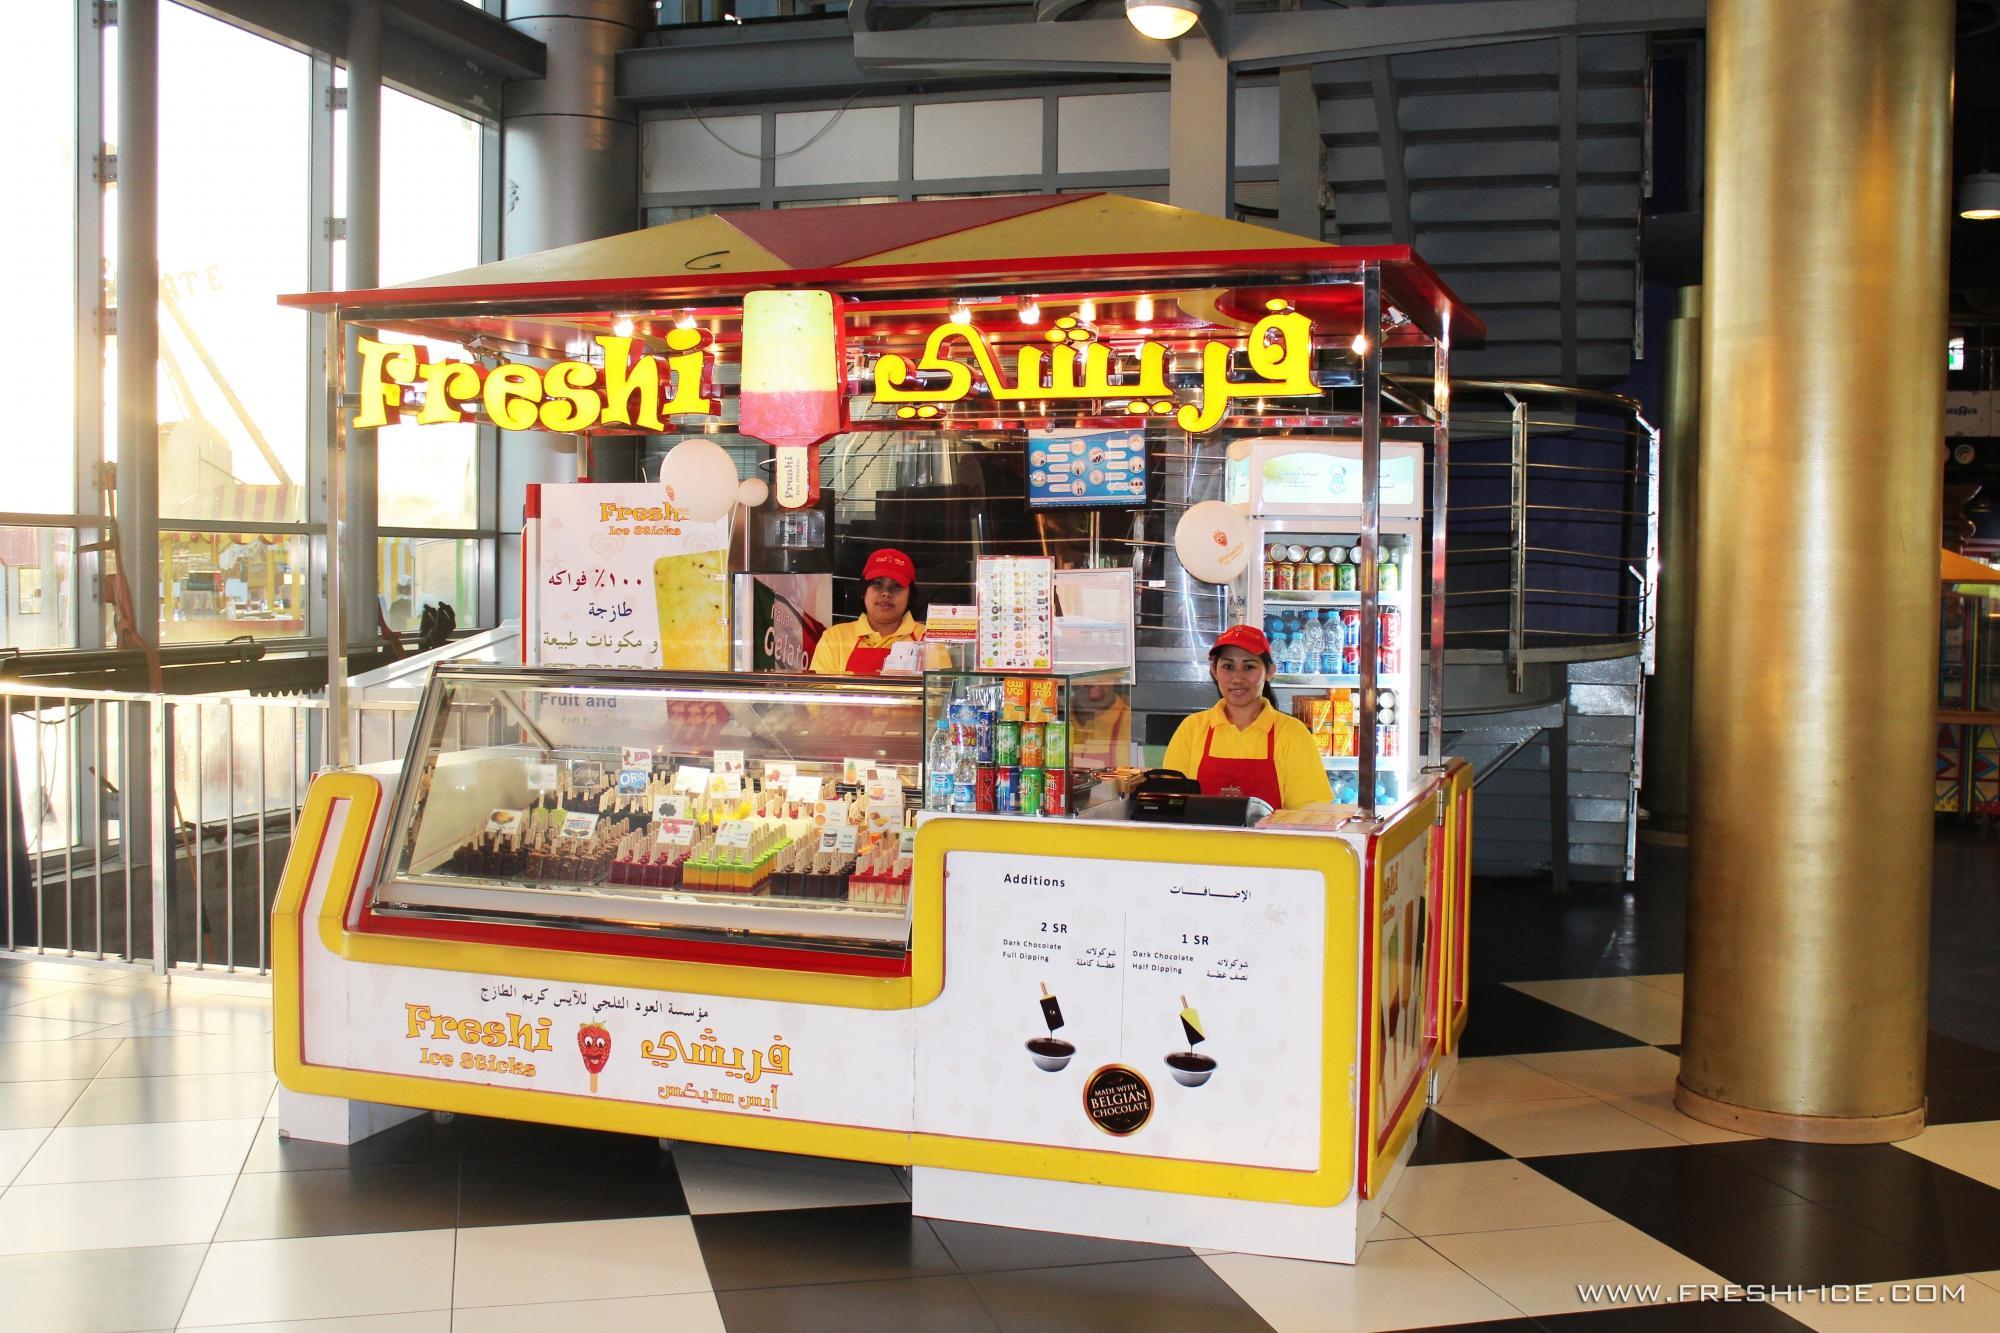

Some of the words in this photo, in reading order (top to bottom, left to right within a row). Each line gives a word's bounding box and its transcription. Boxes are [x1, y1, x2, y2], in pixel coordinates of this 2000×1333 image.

[872, 299, 1325, 433] فريشي
[353, 327, 712, 431] Freshi
[600, 501, 690, 522] Fresh
[608, 525, 631, 536] Ice
[633, 525, 682, 536] Sticks
[548, 570, 587, 591] فواكه
[588, 601, 633, 622] طازجة
[586, 630, 642, 653] مكونات
[764, 626, 809, 670] Gelato
[540, 692, 580, 706] Fruit
[586, 696, 617, 708] and
[1004, 873, 1066, 888] Additions
[1041, 922, 1048, 932] 2
[1053, 923, 1068, 934] SR
[1003, 938, 1021, 947] Dark
[1023, 940, 1062, 950] Chocolate
[1182, 934, 1188, 944] 1
[1194, 935, 1209, 946] SR
[1002, 951, 1017, 959] Full
[1019, 953, 1049, 963] Dipping
[1133, 950, 1151, 958] Dark
[1154, 951, 1194, 962] Chocolate
[1132, 962, 1148, 971] Half
[1151, 964, 1183, 975] Dipping
[480, 983, 517, 1001] الطازج
[522, 988, 549, 1005] كريم
[592, 995, 629, 1013] الثلجي
[635, 997, 663, 1017] العود
[668, 1002, 709, 1022] مؤسسة
[405, 1003, 553, 1053] Freshi
[419, 1047, 454, 1068] Ice
[459, 1051, 537, 1078] Sticks
[641, 1028, 794, 1084] فريشي
[657, 1083, 735, 1105] ستيكس
[1091, 1089, 1147, 1109] BELGIAN
[1094, 1087, 1115, 1096] MADE
[1116, 1083, 1137, 1092] WITH
[1093, 1101, 1149, 1118] CHOCOLATE
